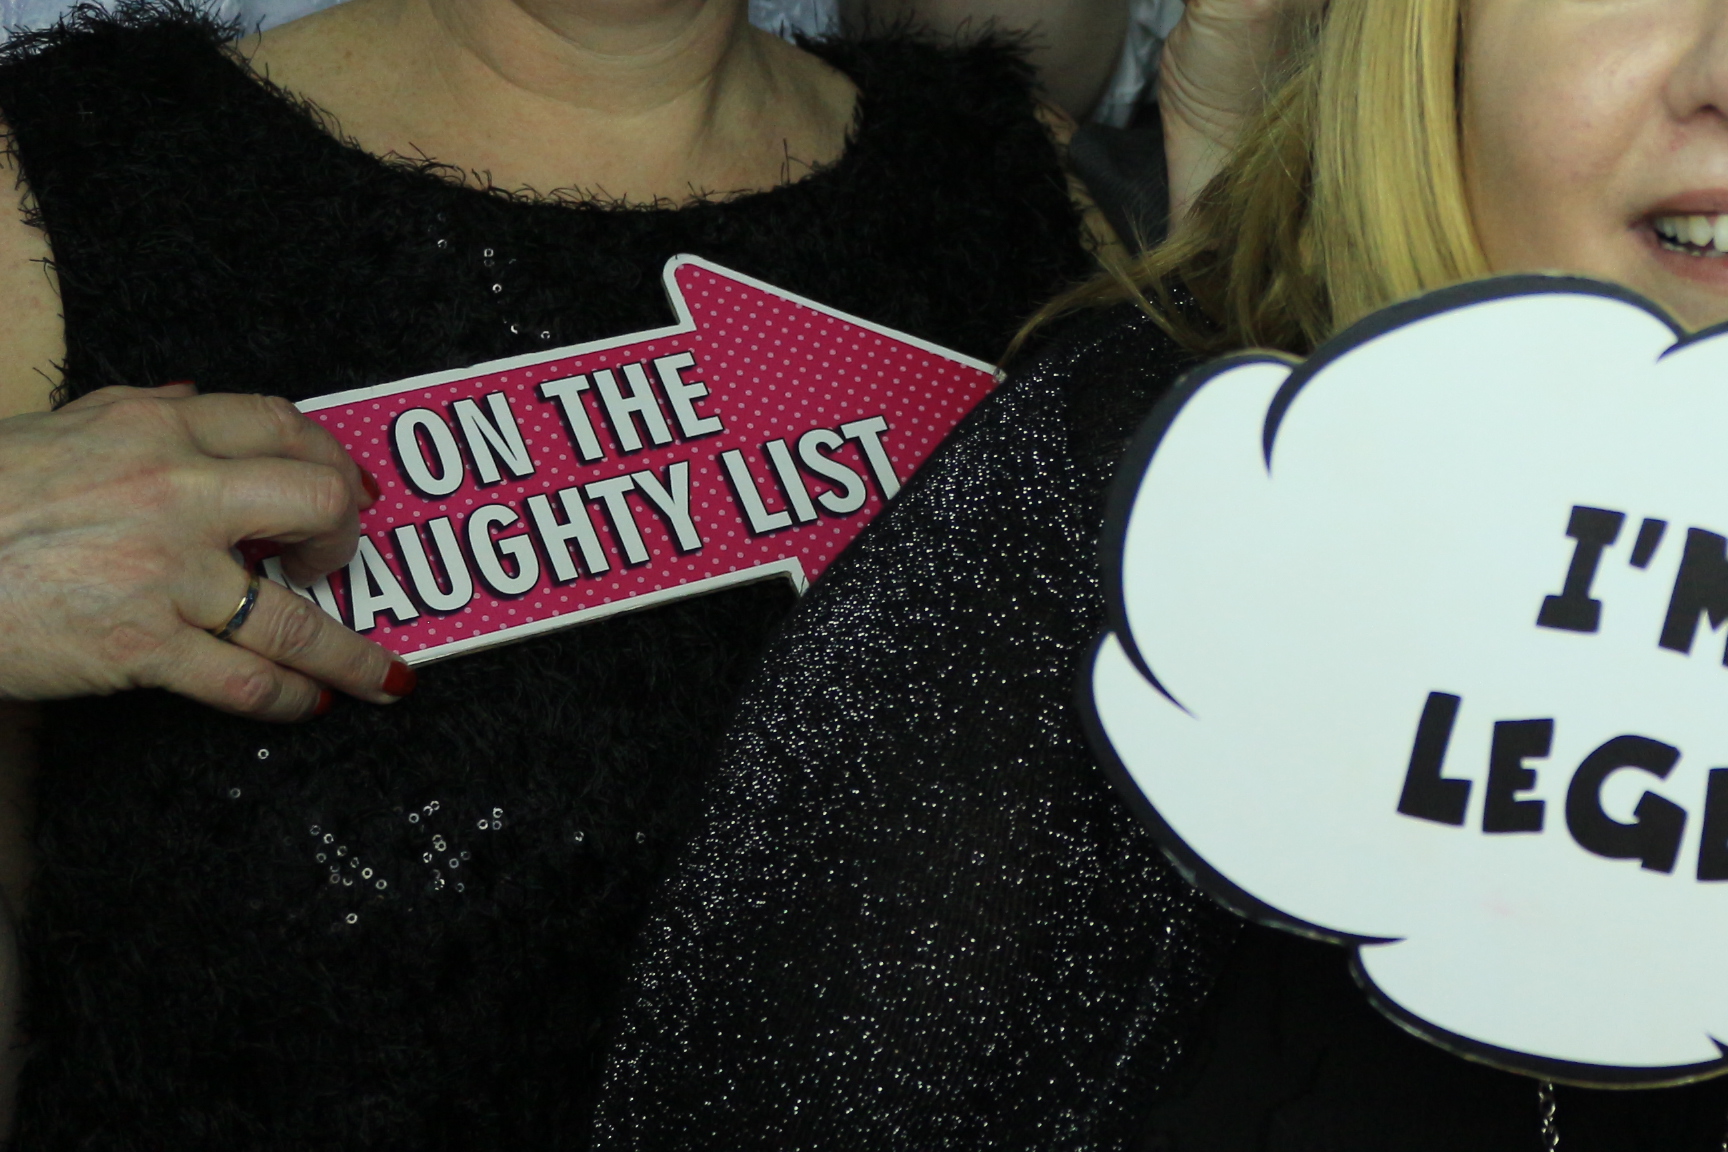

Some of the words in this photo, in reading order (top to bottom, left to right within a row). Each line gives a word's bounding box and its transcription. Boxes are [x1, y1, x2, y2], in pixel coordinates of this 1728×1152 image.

[394, 391, 535, 496] ON
[541, 350, 723, 462] THE
[721, 415, 902, 535] LIST
